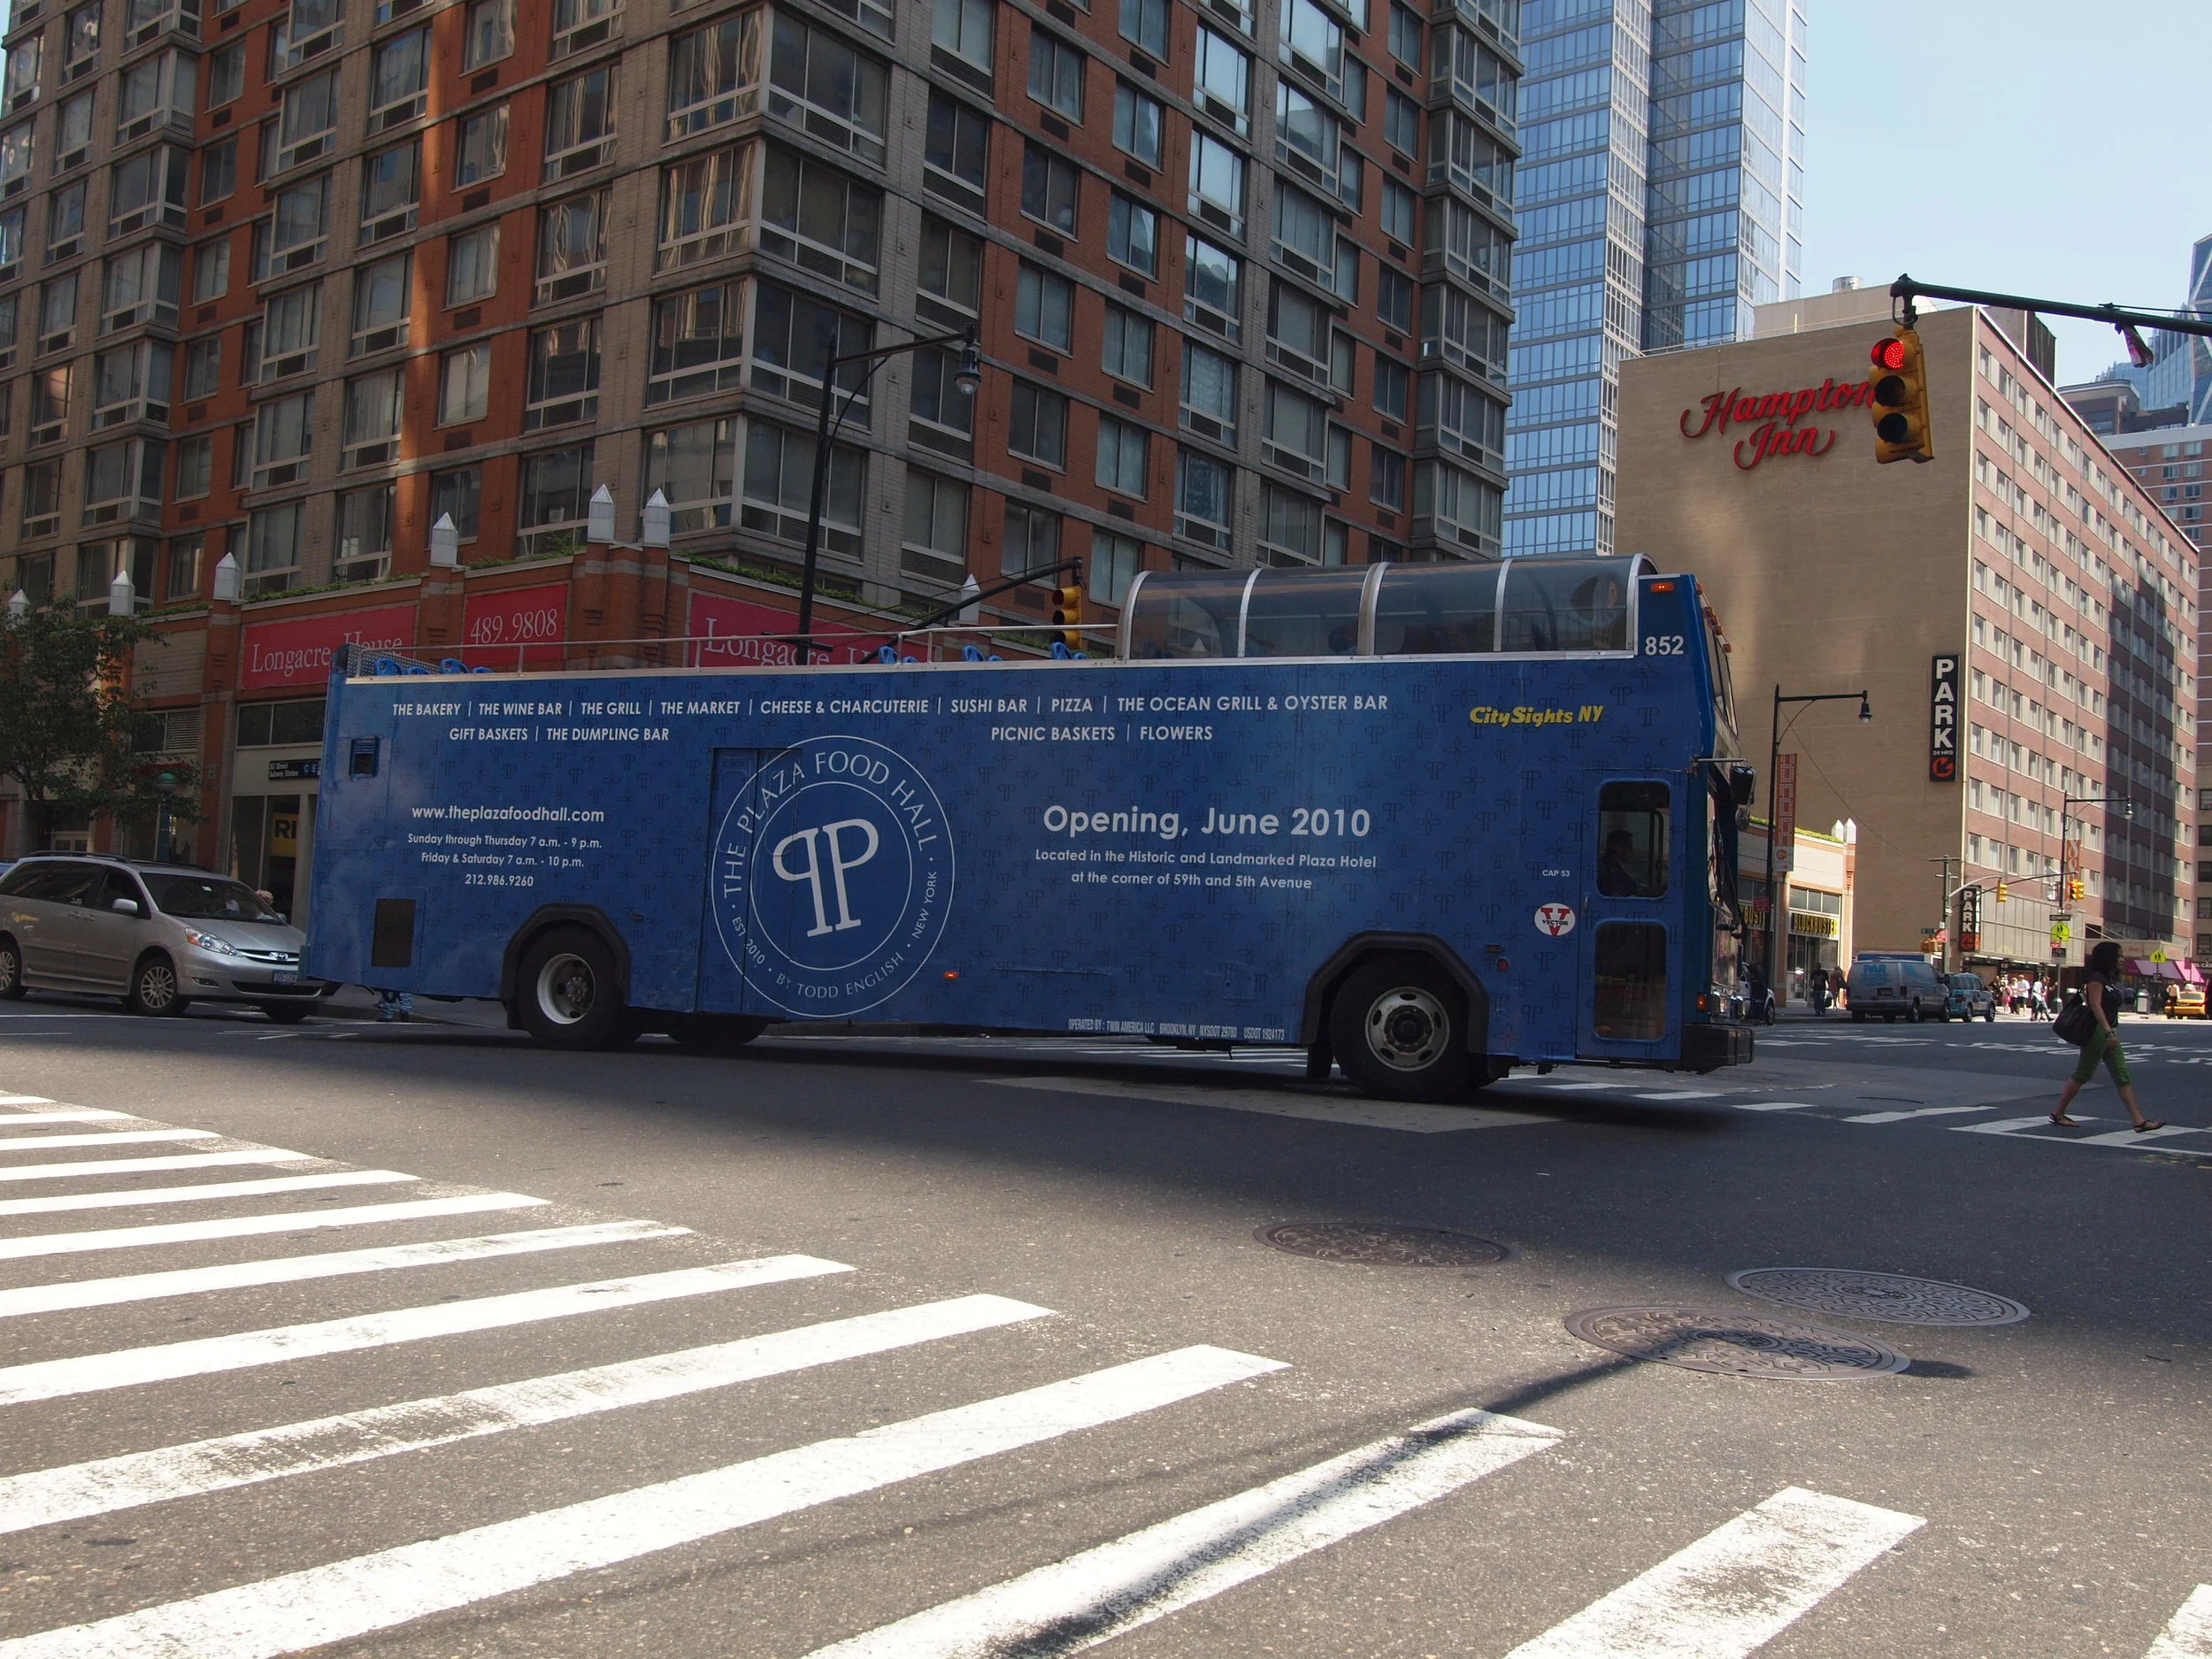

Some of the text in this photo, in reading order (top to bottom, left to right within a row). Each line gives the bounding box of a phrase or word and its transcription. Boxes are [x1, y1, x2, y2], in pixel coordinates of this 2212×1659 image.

[1679, 378, 1875, 438] Hampton
[1733, 420, 1836, 471] Inn
[470, 608, 557, 645] 489.9808
[1645, 635, 1684, 656] 852
[251, 643, 332, 678] Longacre
[393, 695, 1387, 715] THE BAKERY THE WINE BAR THE GRILL THE MARKET CHEESE & CHARCUTERIE SUSHI BAR PIZZA THE OCEAN GRILL & OYSTER BAR
[1933, 658, 1955, 749] PARK
[1469, 705, 1604, 728] CitySights NY
[449, 728, 669, 741] GIFT BASKETS THE DUMPLING BAR
[991, 726, 1213, 741] PICNIC BASKETS FLOWERS
[411, 804, 604, 822] www.theplazafoodhall.com
[724, 751, 937, 898] THE PLAZA FOOD HALL
[1043, 805, 1371, 840] Opening, June 2010
[408, 833, 442, 847] Sunday
[445, 834, 481, 847] through
[485, 835, 527, 848] Thursday
[530, 836, 536, 846] 7
[571, 837, 577, 847] 9
[580, 841, 602, 849] p.m.
[422, 852, 449, 865] Friday
[452, 854, 459, 864] &
[462, 854, 504, 866] Saturday
[508, 855, 513, 864] 7
[549, 856, 559, 866] 10
[561, 859, 584, 868] p.m.
[1035, 849, 1376, 867] Located in the Historic and Landmarked Plaza Hotel
[465, 874, 534, 887] 212.986.9260
[1071, 872, 1312, 888] at the corner of 59th and 5th Avenue
[911, 871, 937, 939] NEW YORK
[1962, 890, 1973, 933] PARK
[744, 939, 765, 964] 2010
[776, 951, 904, 998] BY TODD ENGLISH
[1069, 1018, 1094, 1030] OPERATED
[1120, 1021, 1144, 1033] AMERICA
[1145, 1022, 1155, 1033] LLC
[1188, 1024, 1196, 1036] NY
[1200, 1025, 1220, 1037] NYSDOT
[1244, 1026, 1261, 1039] USDOT
